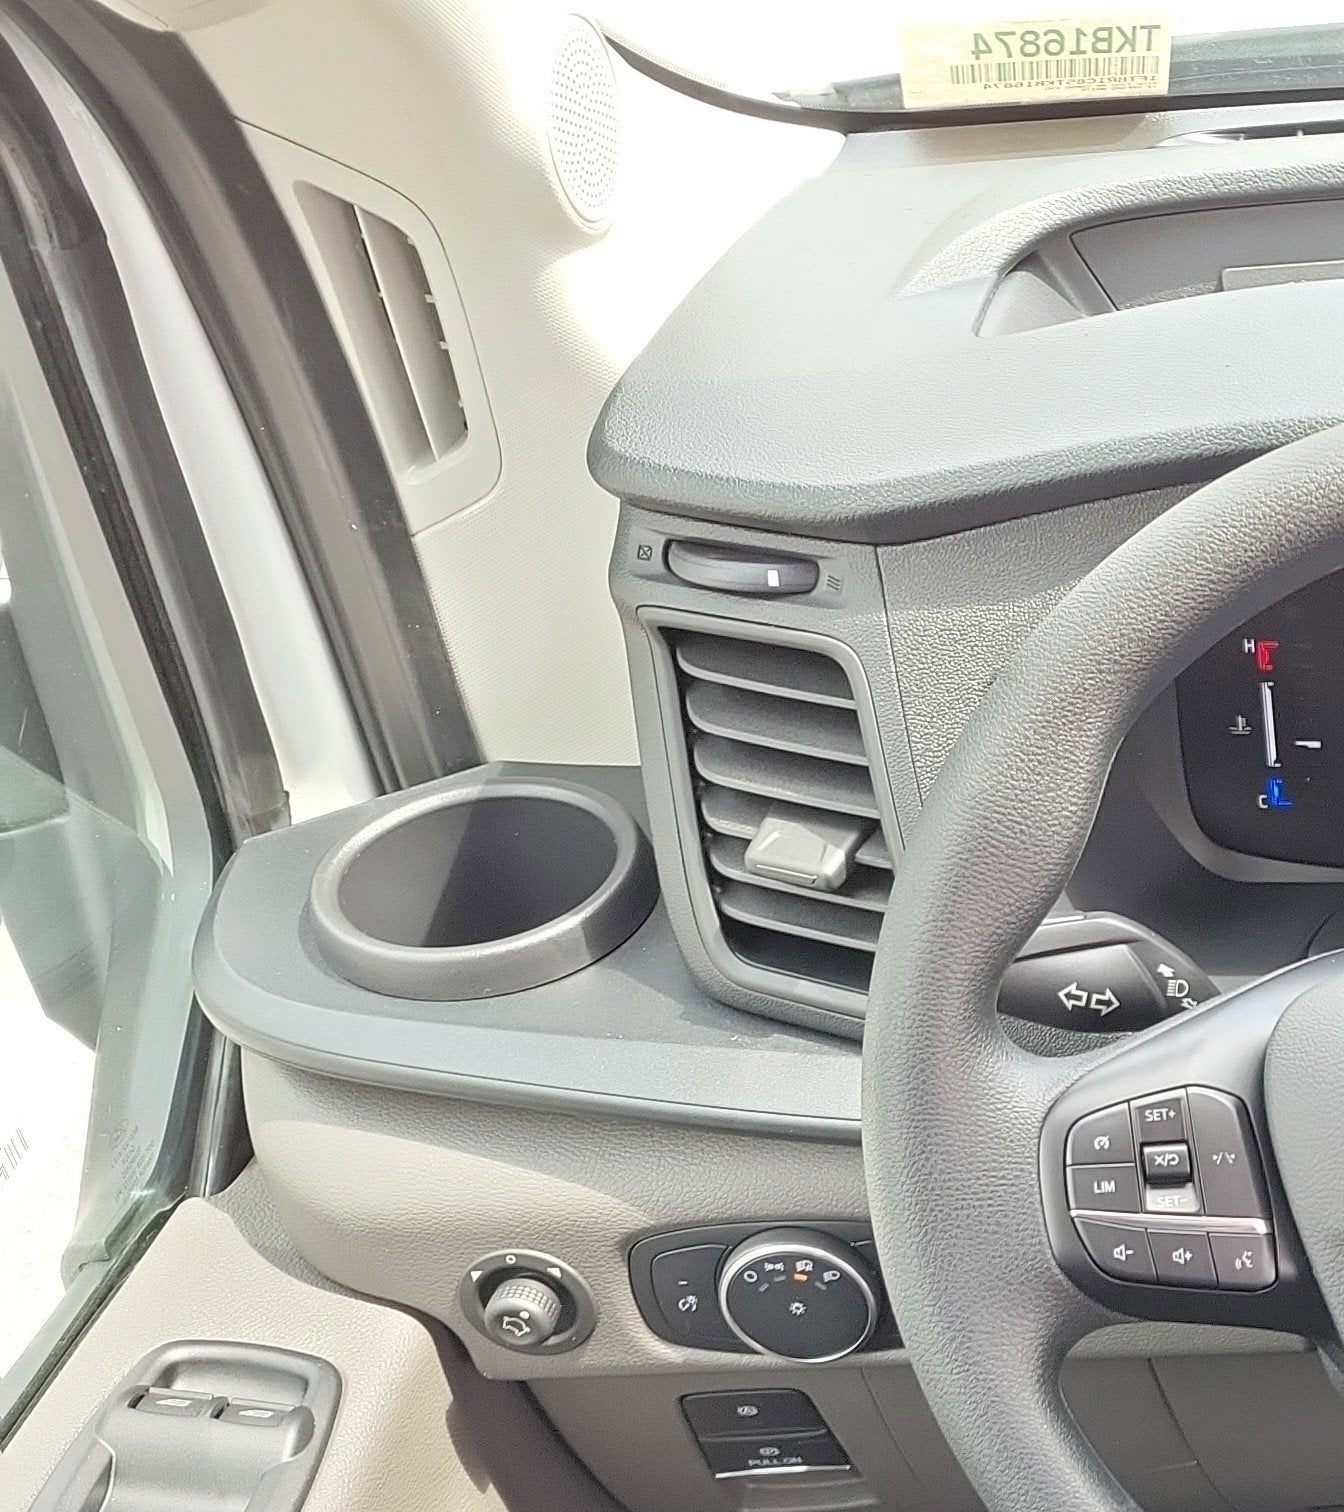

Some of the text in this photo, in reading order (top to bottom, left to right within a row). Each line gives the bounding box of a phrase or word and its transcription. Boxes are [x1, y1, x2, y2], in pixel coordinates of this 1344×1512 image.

[1244, 638, 1256, 653] H
[1258, 795, 1268, 809] C
[1094, 1179, 1116, 1194] LIM
